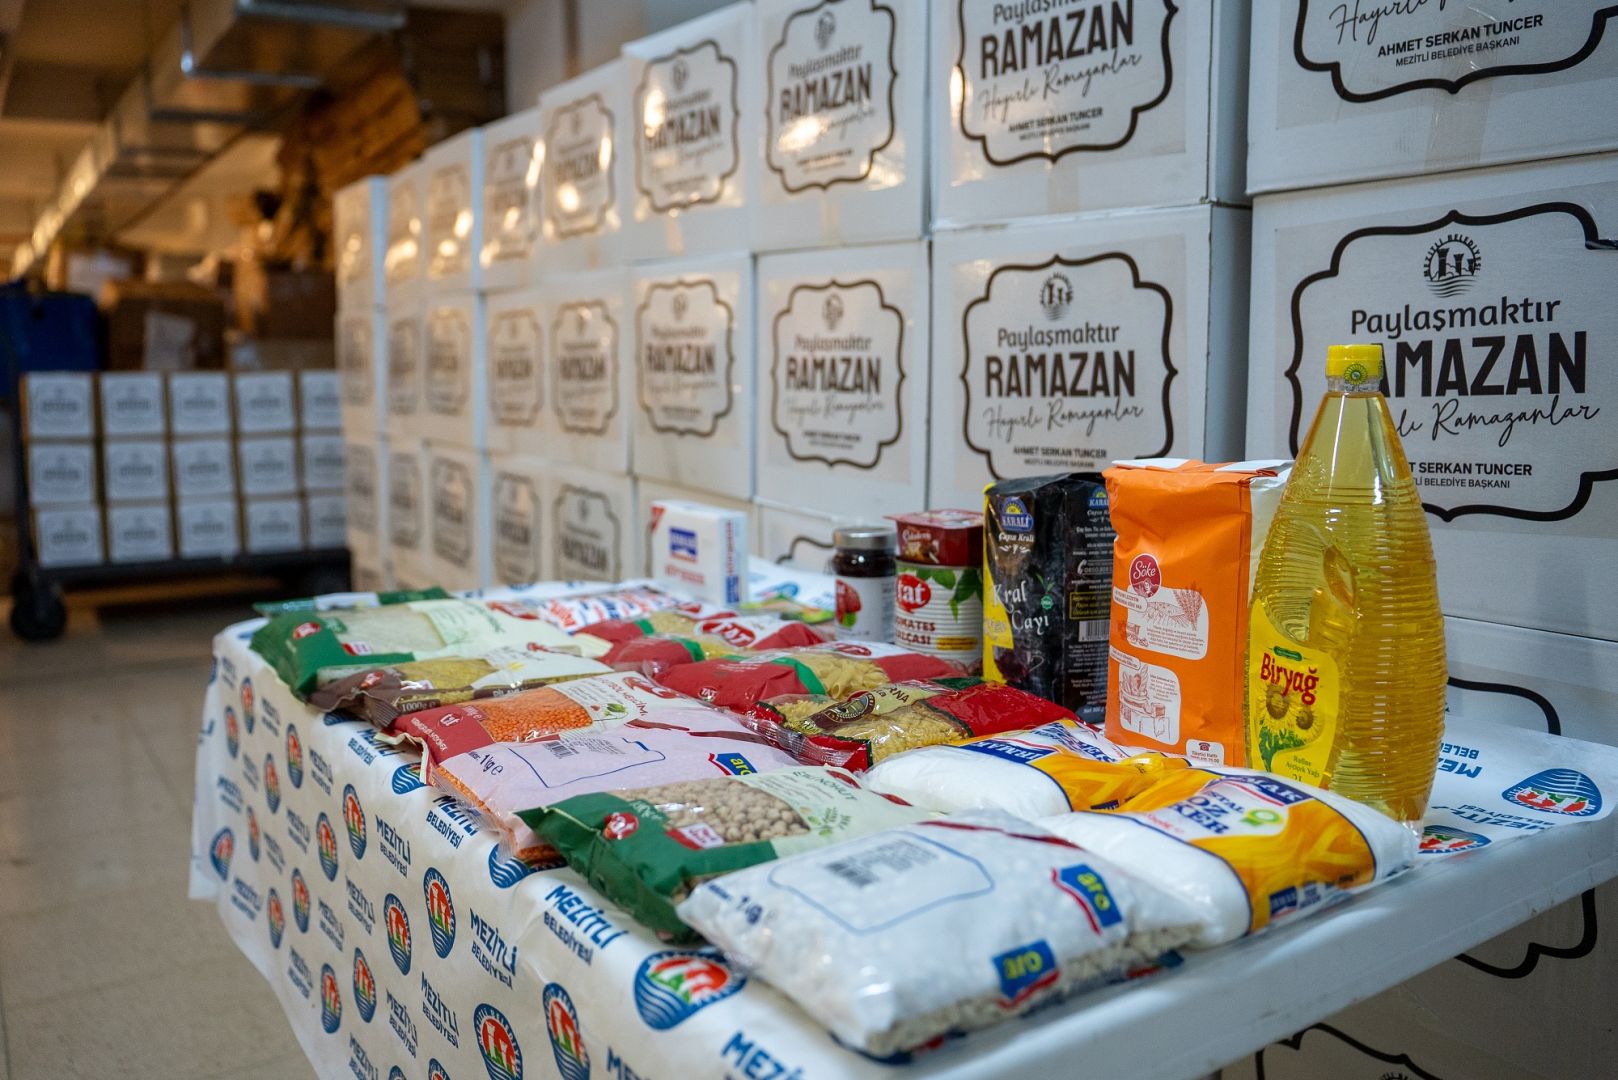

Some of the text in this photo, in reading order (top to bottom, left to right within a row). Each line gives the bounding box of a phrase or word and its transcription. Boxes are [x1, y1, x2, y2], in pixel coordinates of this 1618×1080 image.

[980, 0, 1133, 80] RAMAZAN
[1377, 14, 1543, 58] AHMET SERKAN TUNCER
[1395, 36, 1520, 67] MEZİTLİ BELEDİYE BAŞKANI
[1043, 48, 1142, 99] Ramazanlar
[1070, 107, 1103, 122] TUNCER
[998, 322, 1120, 352] Paylaşmaktır
[1351, 296, 1561, 339] Paylaşmaktır
[786, 356, 881, 395] RAMAZAN
[985, 350, 1135, 398] RAMAZAN
[1047, 397, 1144, 437] Ramazanlar
[1432, 395, 1600, 447] Ramazanlar
[1041, 447, 1072, 457] SERKAN
[1074, 447, 1107, 458] TUNCER
[1419, 462, 1472, 475] SERKAN
[1475, 463, 1532, 476] TUNCER
[1424, 476, 1467, 488] BELEDİYE
[1468, 479, 1510, 490] BAŞKANI
[1133, 561, 1156, 579] Söke
[993, 580, 1028, 612] Kral
[1260, 652, 1319, 706] Biryağ
[375, 814, 411, 866] MEZİTLİ
[426, 809, 464, 850] BELEDİYESİ
[379, 842, 408, 879] BELEDİYESİ
[345, 874, 375, 925] MEZİTLİ
[545, 885, 629, 949] MEZİTLİ
[470, 908, 517, 976] MEZİTLİ
[543, 911, 594, 966] BELEDİYESİ
[471, 941, 514, 991] BELEDİYESİ
[386, 987, 418, 1048] MEZİTLİ
[421, 971, 459, 1037] MEZİTLİ
[423, 1000, 459, 1049] BELEDİYESİ
